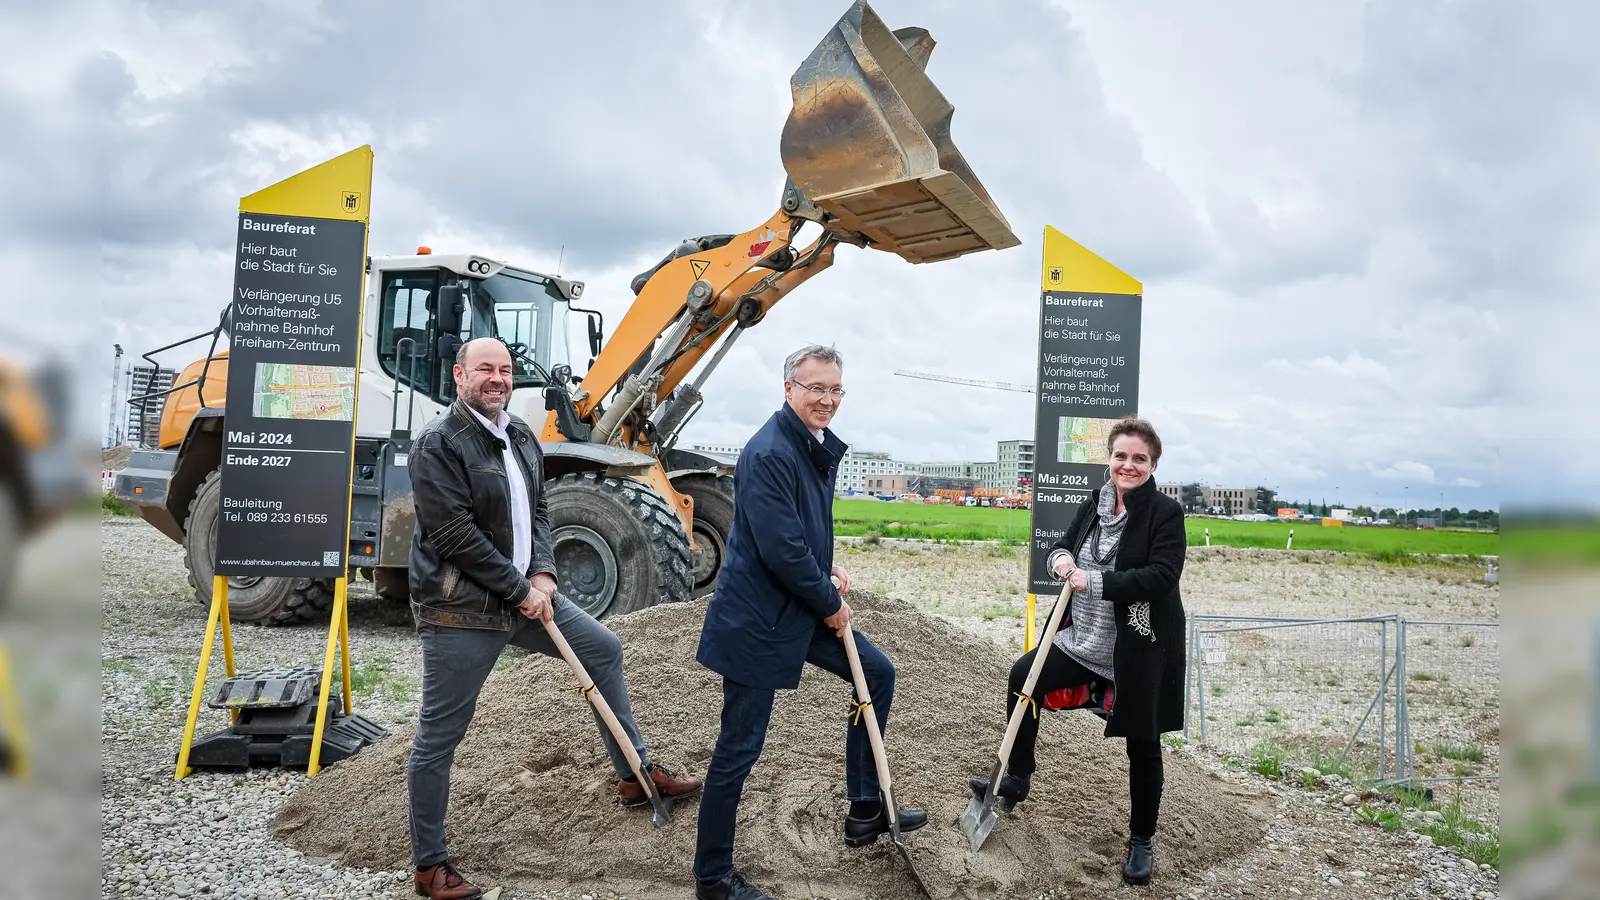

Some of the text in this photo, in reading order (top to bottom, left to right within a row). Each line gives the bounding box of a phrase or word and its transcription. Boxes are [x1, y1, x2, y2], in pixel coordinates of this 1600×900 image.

[243, 219, 315, 235] Baureferat
[242, 242, 297, 257] Hier baut
[241, 259, 337, 276] die Stadt für Sie
[238, 288, 341, 305] Verlängerung U5
[1046, 296, 1103, 307] Baureferat
[238, 303, 320, 319] Vorhaltemaß-
[1045, 316, 1088, 326] Hier baut
[236, 321, 334, 336] nahme Bahnhof
[1044, 329, 1120, 341] die Stadt für Sie
[235, 336, 340, 352] Freiham-Zentrum
[1044, 353, 1125, 367] Verlängerung U5
[1043, 366, 1108, 378] Vorhaltemaß-
[1042, 380, 1120, 392] nahme Bahnhof
[1042, 393, 1125, 406] Freiham-Zentrum
[228, 431, 292, 444] Mai 2024
[227, 455, 291, 466] Ende 2027
[1038, 474, 1088, 485] Mai 2024
[1038, 493, 1062, 502] Ende
[224, 498, 282, 510] Bauleitung
[224, 512, 327, 523] Tel. 089 233 61555
[1036, 529, 1064, 538] Bauleit
